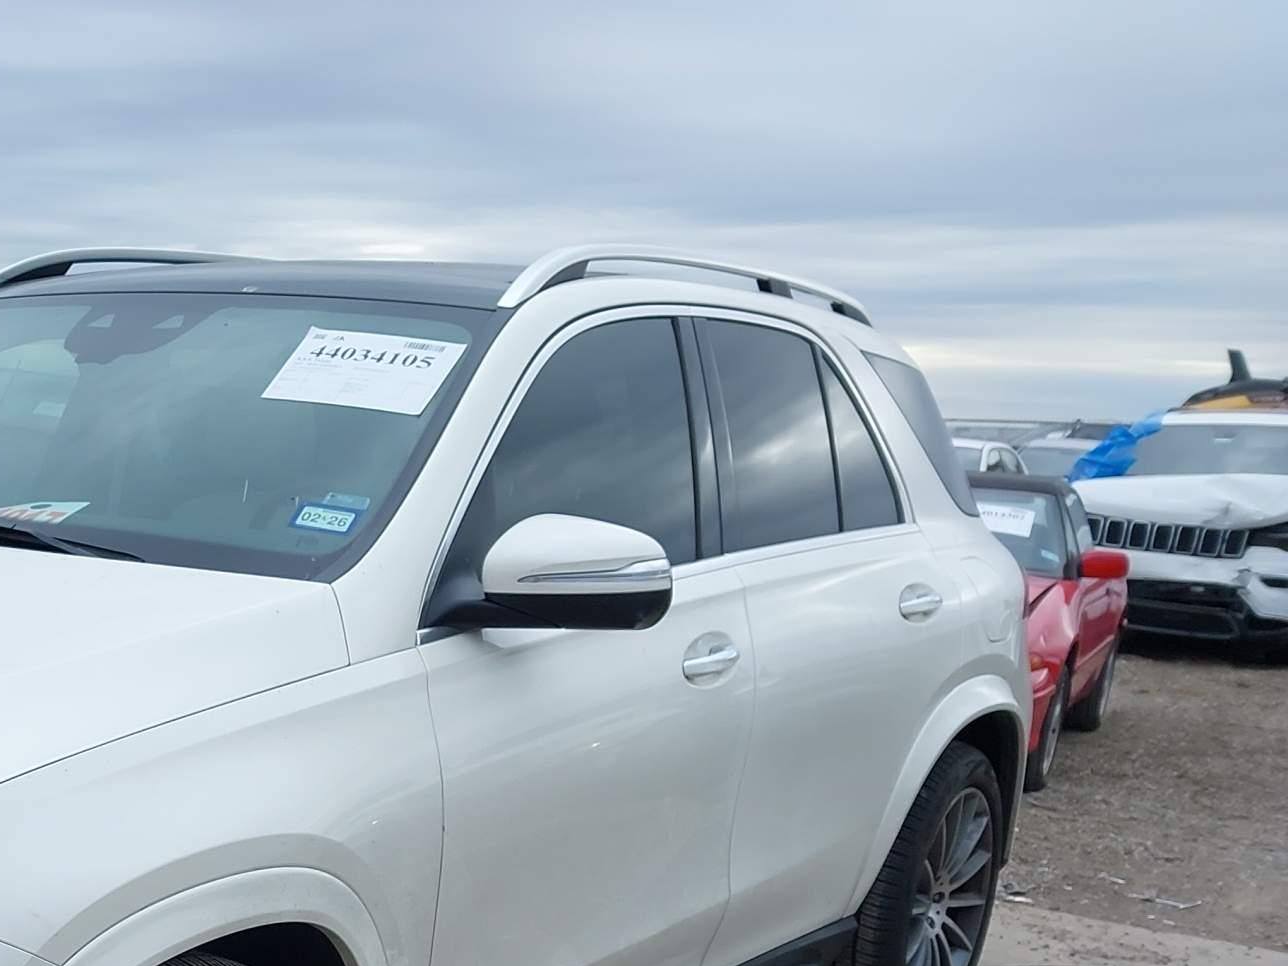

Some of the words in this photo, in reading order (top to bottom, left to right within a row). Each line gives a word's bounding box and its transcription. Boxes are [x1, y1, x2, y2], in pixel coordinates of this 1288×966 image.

[309, 345, 437, 370] 44034105
[301, 511, 322, 523] 02
[327, 515, 349, 528] 26
